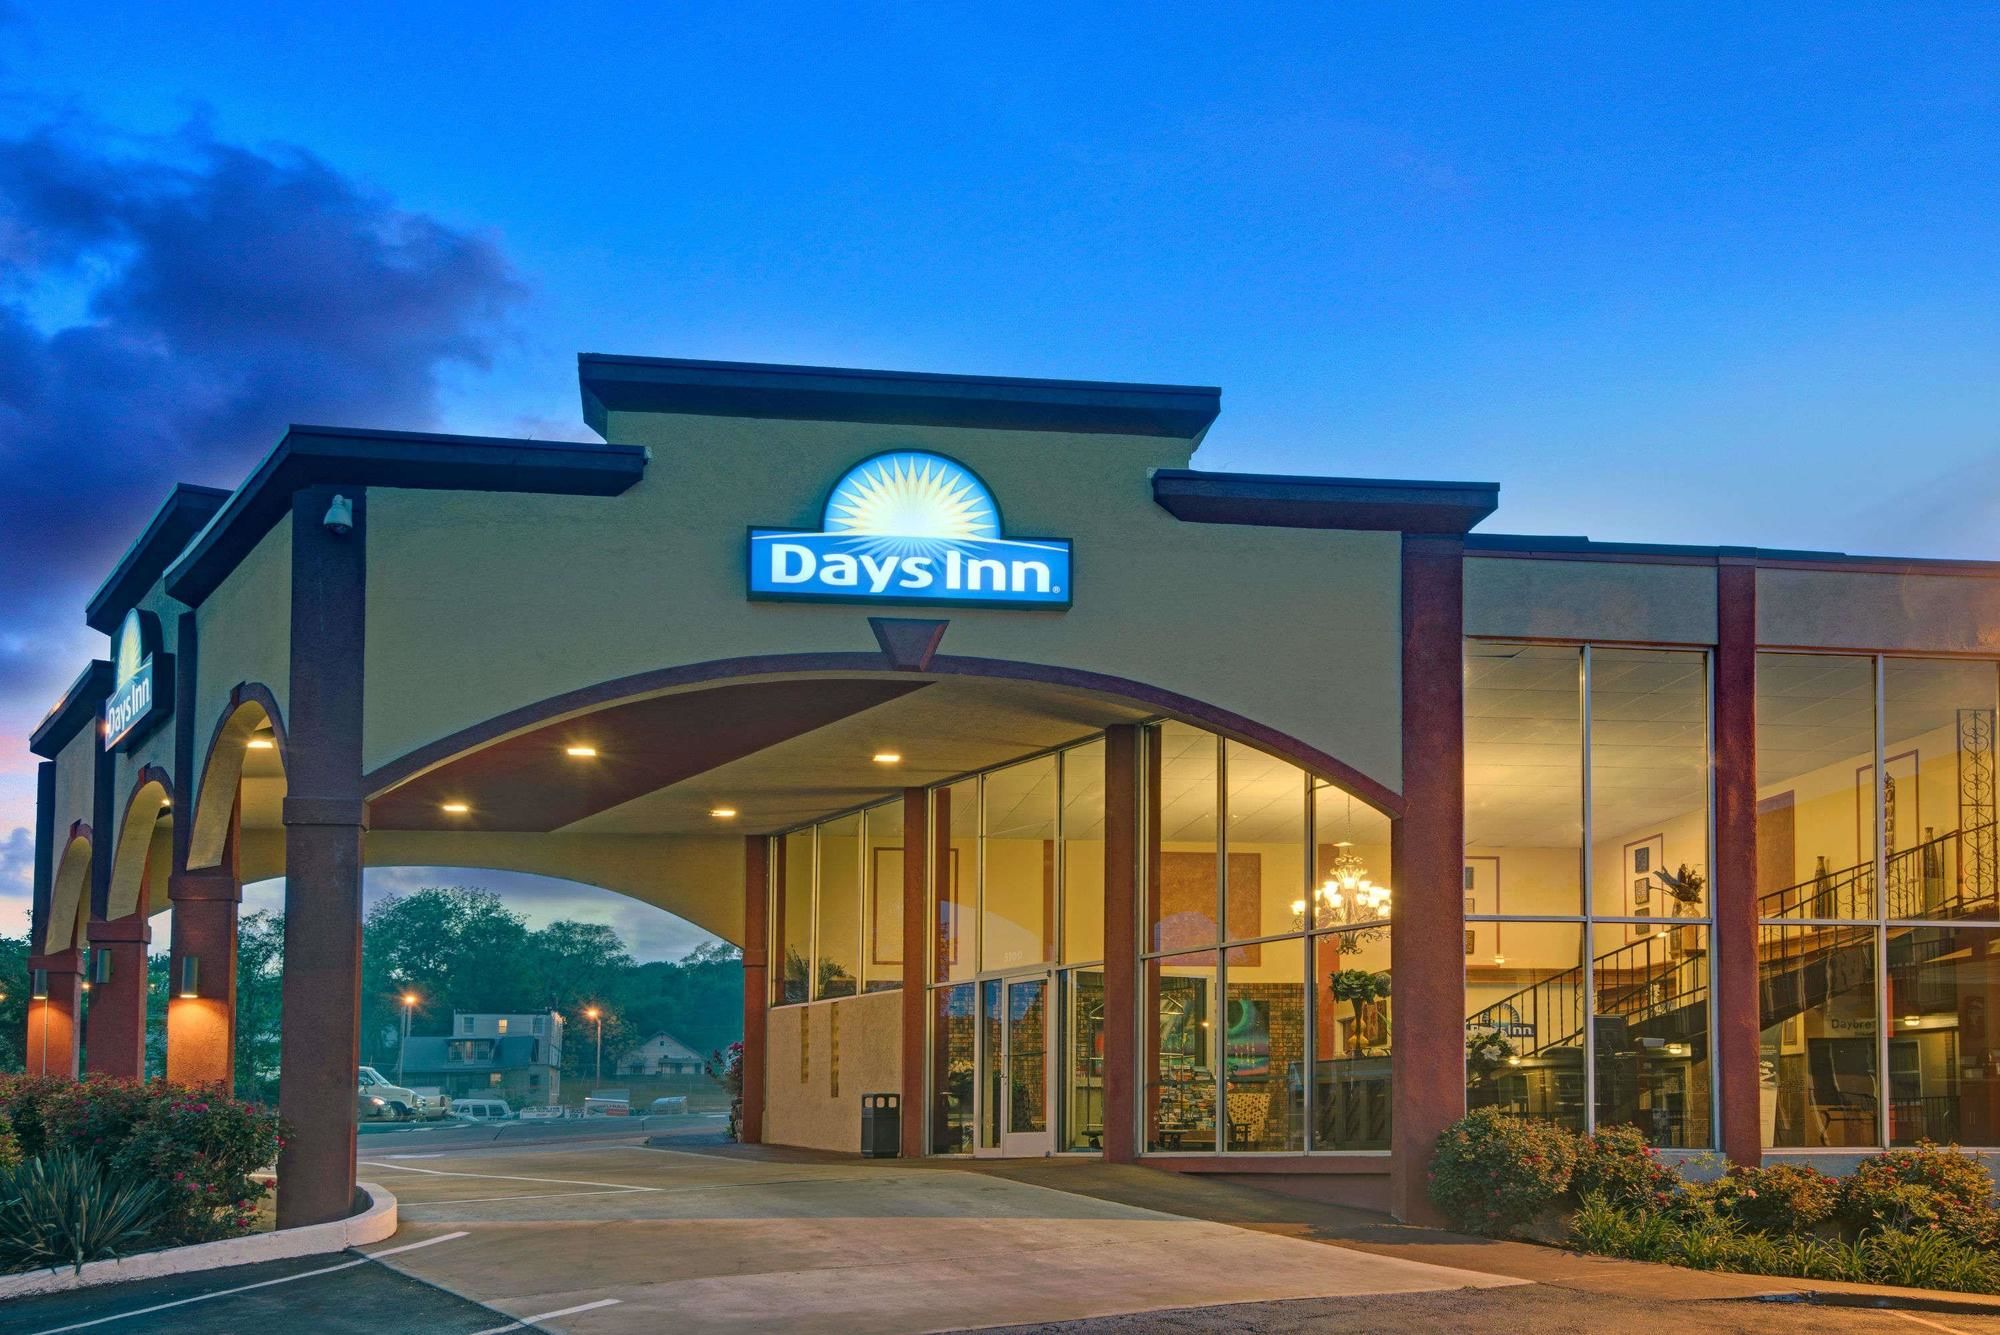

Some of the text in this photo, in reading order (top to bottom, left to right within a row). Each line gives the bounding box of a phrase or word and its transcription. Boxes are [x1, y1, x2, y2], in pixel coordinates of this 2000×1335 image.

[771, 543, 1050, 593] Days Inn
[109, 678, 149, 738] Days Inn
[1508, 1025, 1532, 1035] Inn
[1831, 1019, 1873, 1030] Daybre
